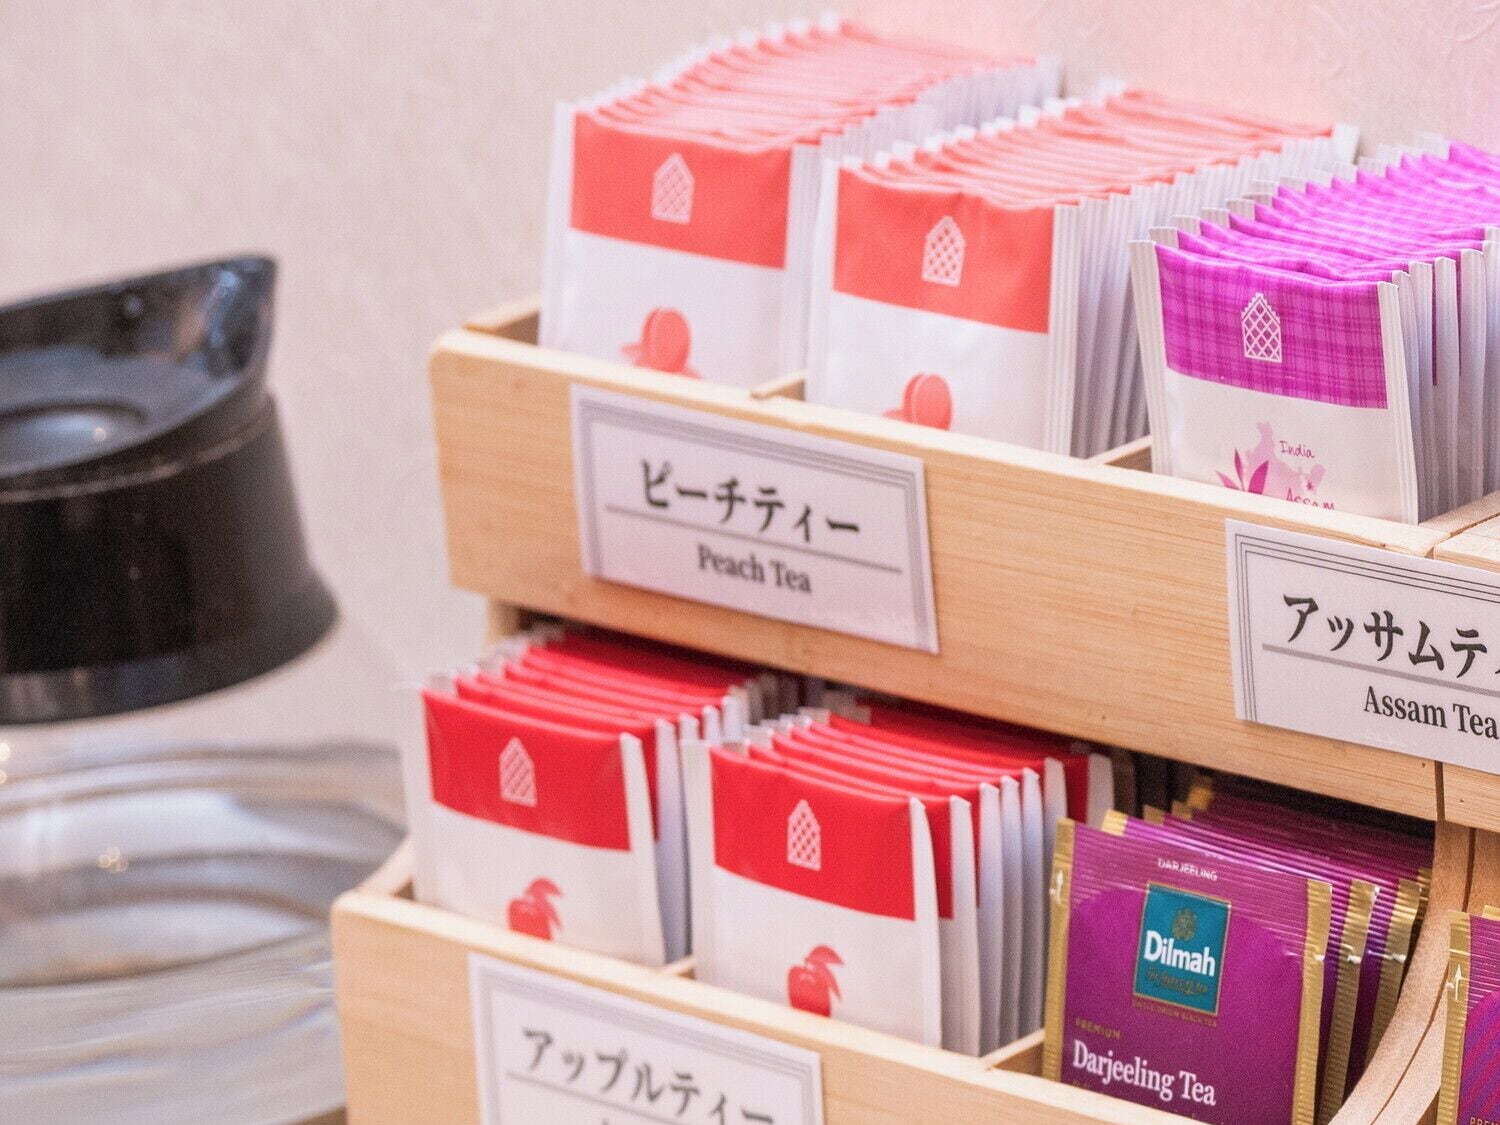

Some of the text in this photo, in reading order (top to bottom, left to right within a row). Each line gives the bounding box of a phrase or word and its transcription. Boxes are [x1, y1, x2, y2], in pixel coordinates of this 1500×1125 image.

[1279, 439, 1316, 459] India
[640, 458, 861, 543] ピーチティー
[697, 542, 813, 595] Peach Tea
[1363, 686, 1500, 741] Assam Tea
[1157, 857, 1218, 881] DARJEELING
[1143, 929, 1216, 977] Dilmah
[1072, 1038, 1217, 1106] Darjeeling Tea
